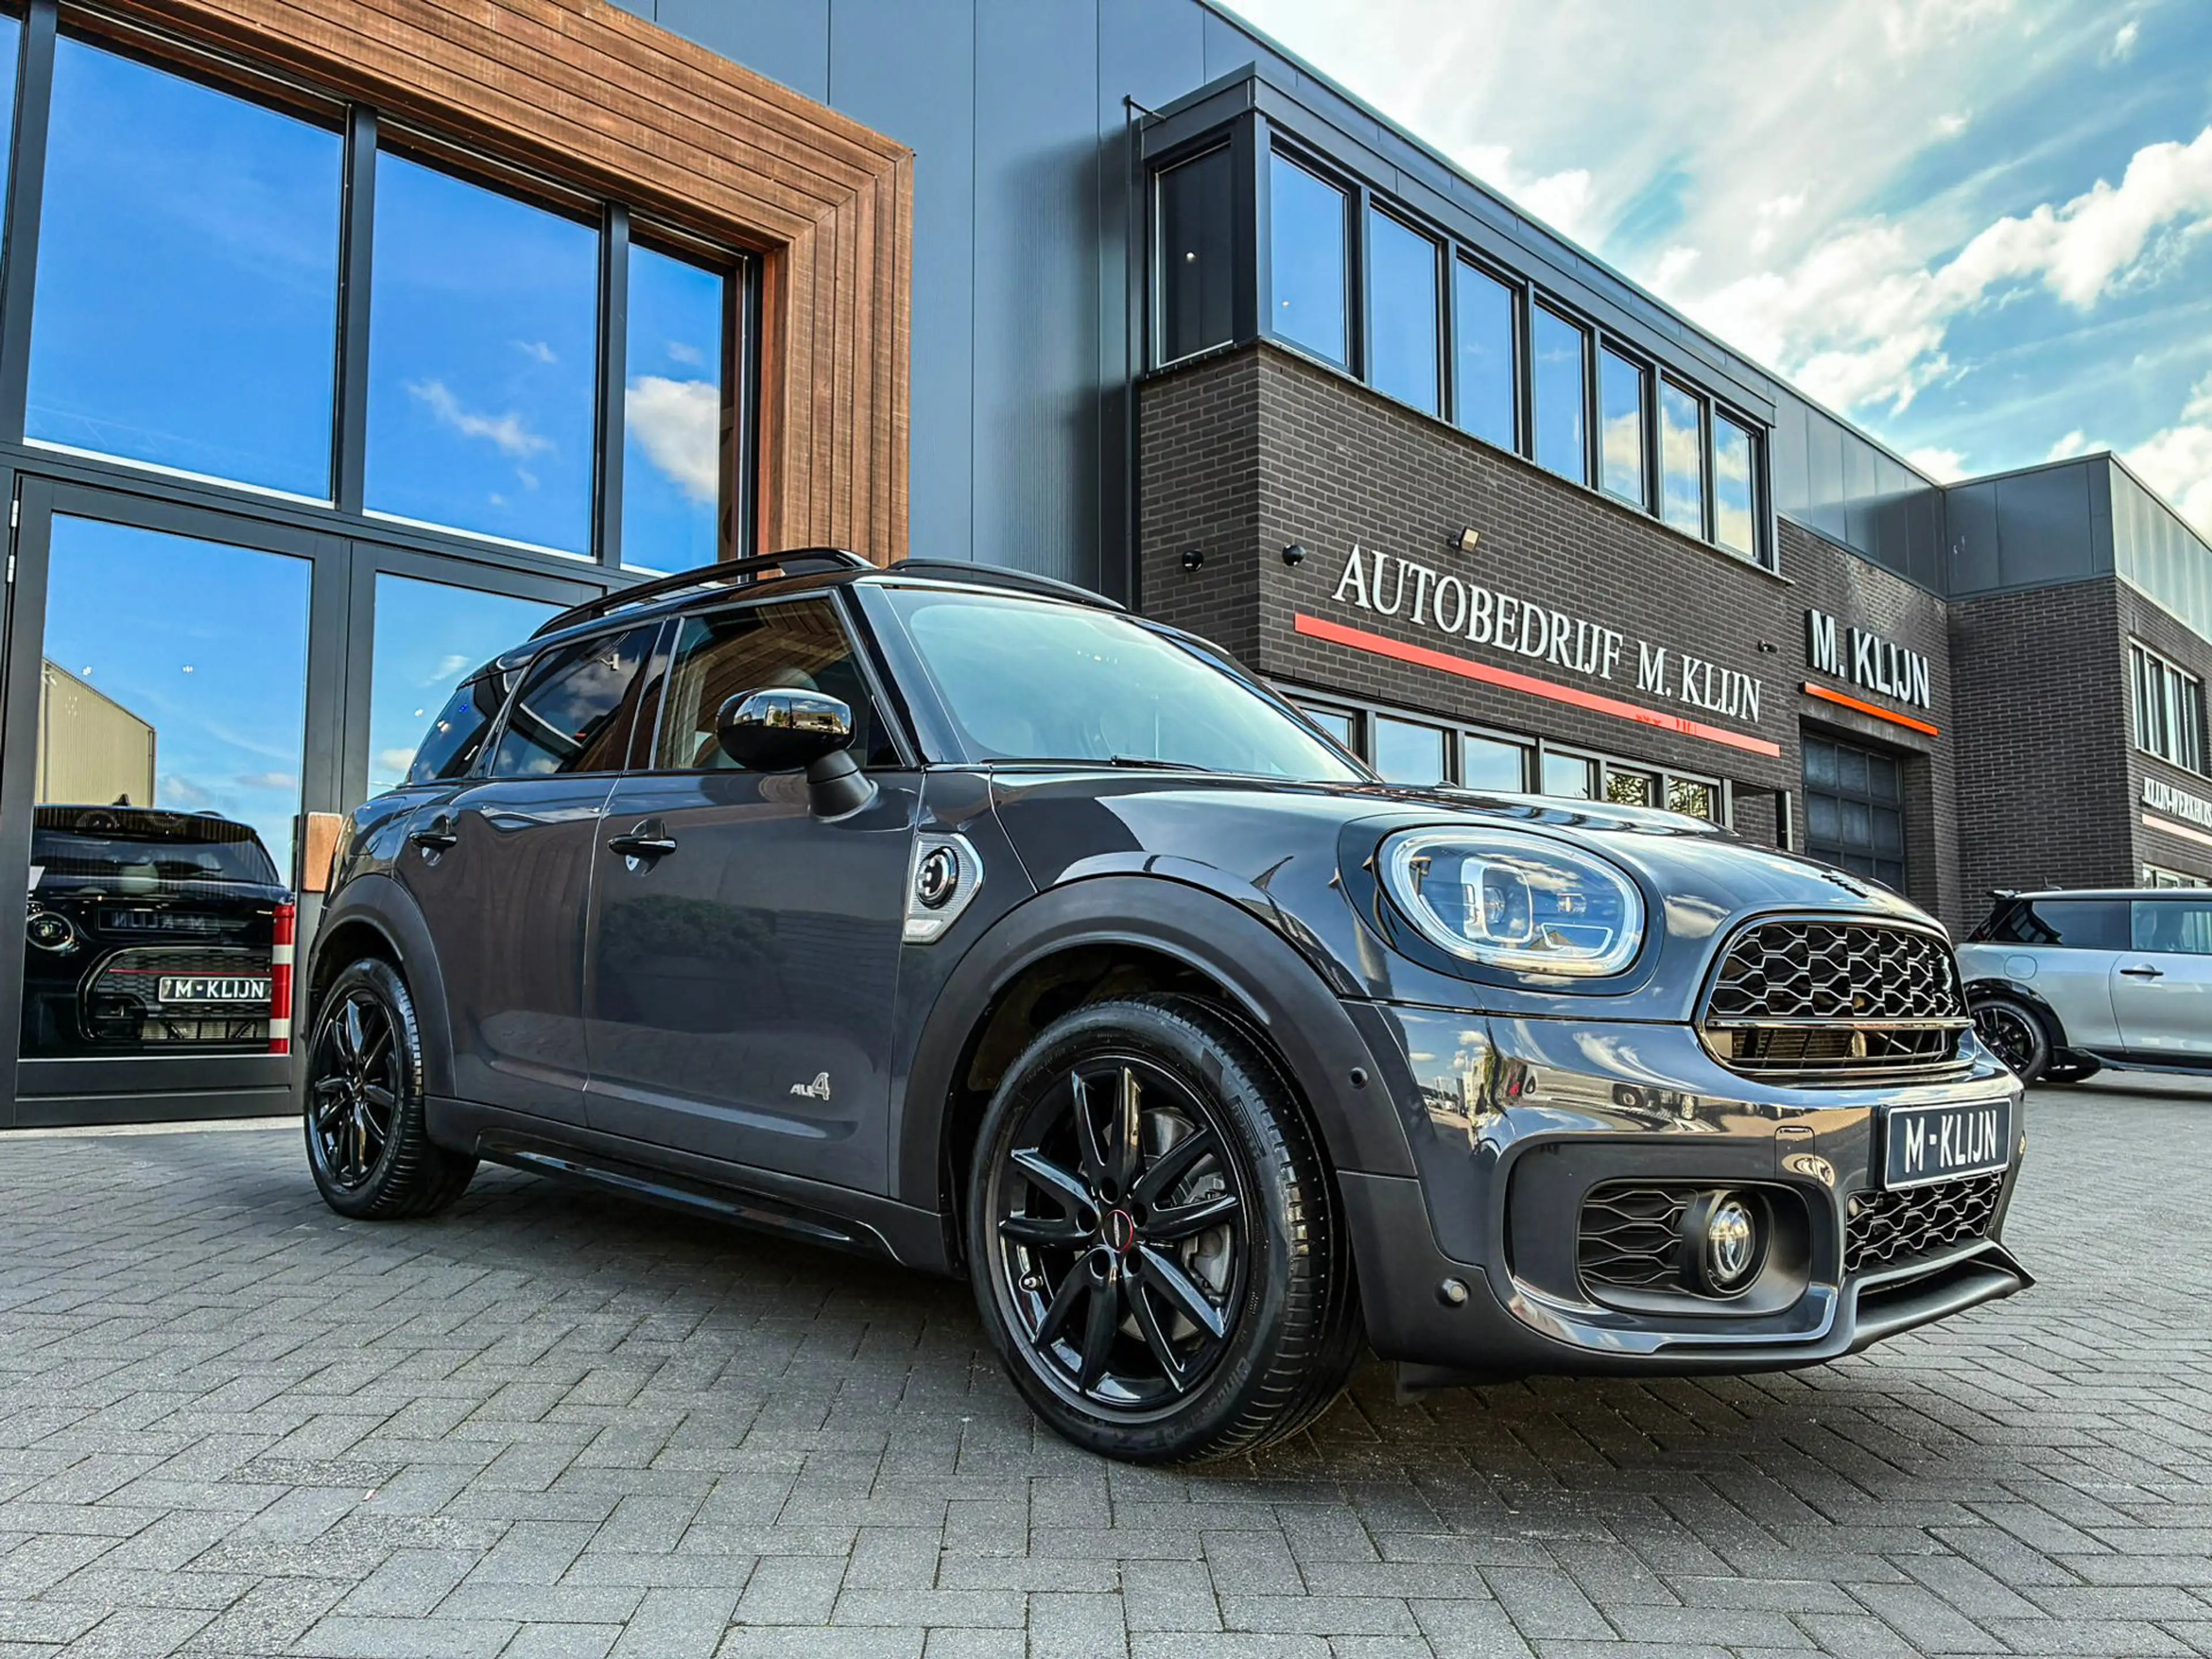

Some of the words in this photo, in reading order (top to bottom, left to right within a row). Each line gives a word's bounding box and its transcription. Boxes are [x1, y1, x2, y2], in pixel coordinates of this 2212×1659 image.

[1331, 544, 1623, 680] AUTOBEDRIJF
[1635, 639, 1672, 697] M.
[1680, 654, 1763, 724] KLIJN
[1810, 608, 1845, 677] M.
[1851, 626, 1930, 709] KLIJN
[175, 979, 265, 999] M-KLIJN
[1904, 1109, 1998, 1174] M-KLIJN
